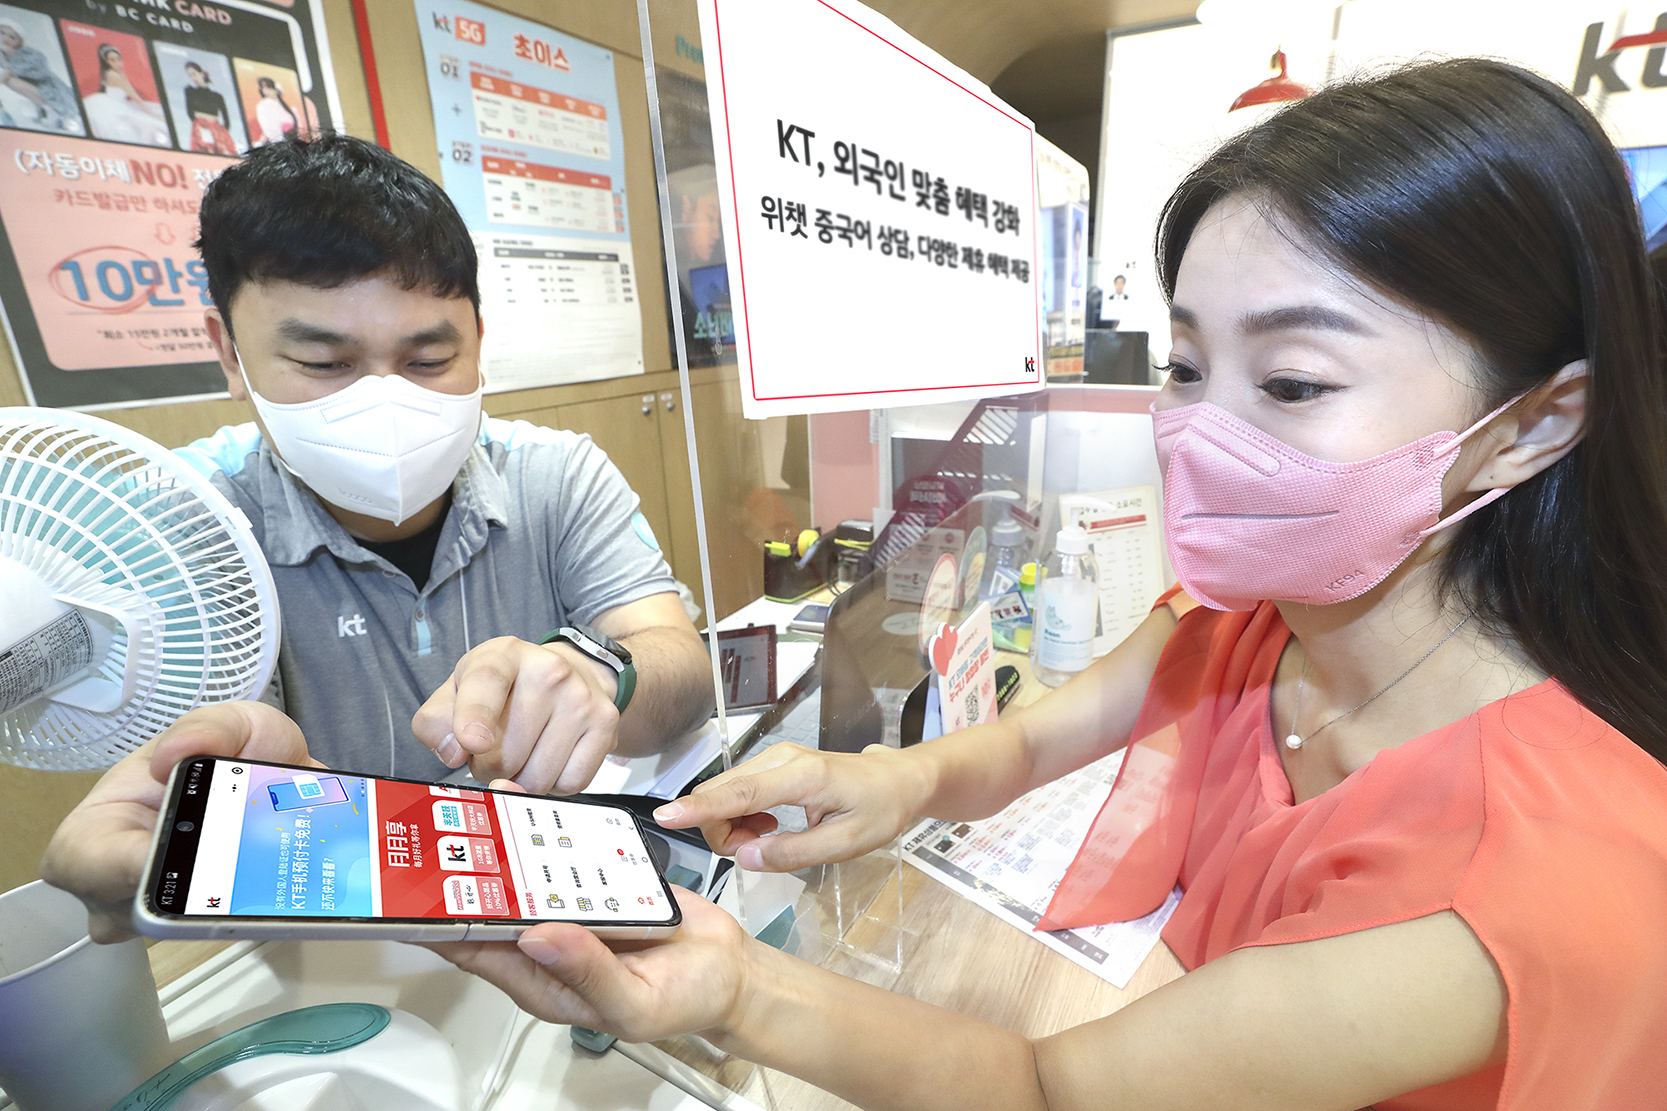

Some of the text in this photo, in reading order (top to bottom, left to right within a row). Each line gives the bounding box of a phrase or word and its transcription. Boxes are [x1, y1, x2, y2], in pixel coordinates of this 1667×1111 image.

[115, 4, 140, 21] BC
[146, 12, 194, 33] CARD
[174, 0, 232, 25] CARD
[432, 12, 482, 43] kt 5G
[513, 34, 570, 73] 초이스
[440, 62, 459, 79] 01
[14, 148, 188, 189] (자동이체NO!
[451, 148, 472, 164] 02
[777, 118, 1021, 236] KT, 외국인 맞춤 혜택 강화
[760, 195, 1030, 284] 위챗 중국어 상담, 다양한 제휴 혜택 제공
[1025, 356, 1035, 373] kt
[1326, 568, 1366, 592] KF94
[338, 613, 367, 638] kt
[385, 820, 410, 868] 月月享
[446, 844, 466, 862] kt
[161, 881, 177, 905] KT 3:21
[207, 897, 221, 909] kt
